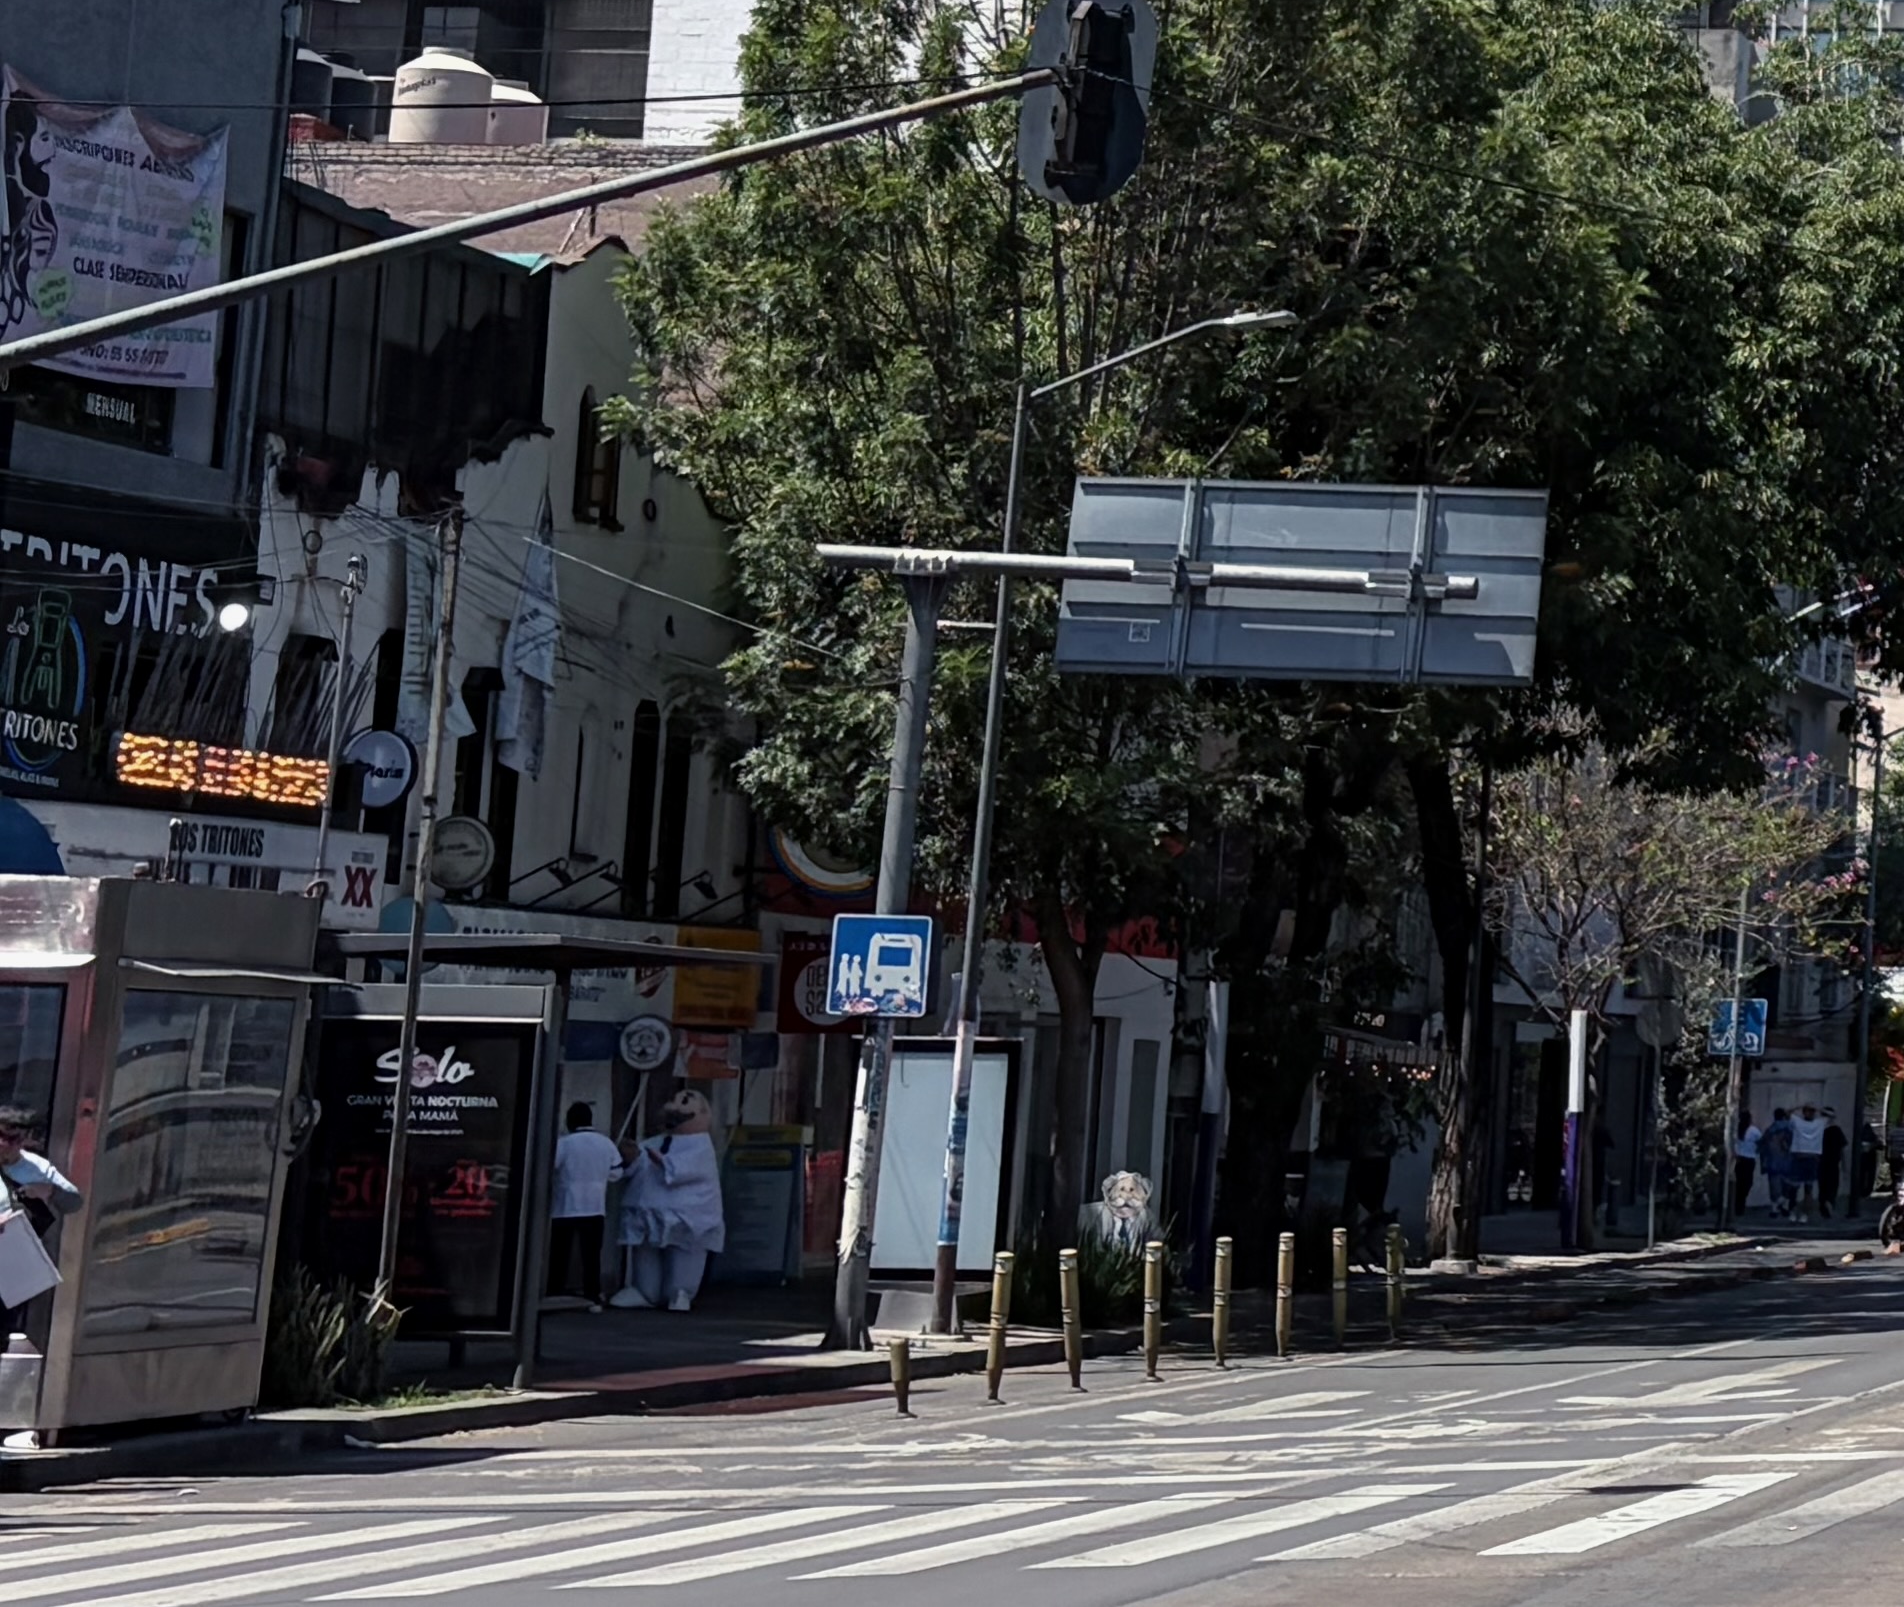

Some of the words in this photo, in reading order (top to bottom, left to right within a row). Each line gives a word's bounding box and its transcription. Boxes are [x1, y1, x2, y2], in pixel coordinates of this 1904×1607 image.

[200, 824, 265, 858] TRITONES
[340, 865, 378, 908] XX
[384, 1095, 426, 1108] VTA
[427, 1095, 499, 1108] NOCTURNA
